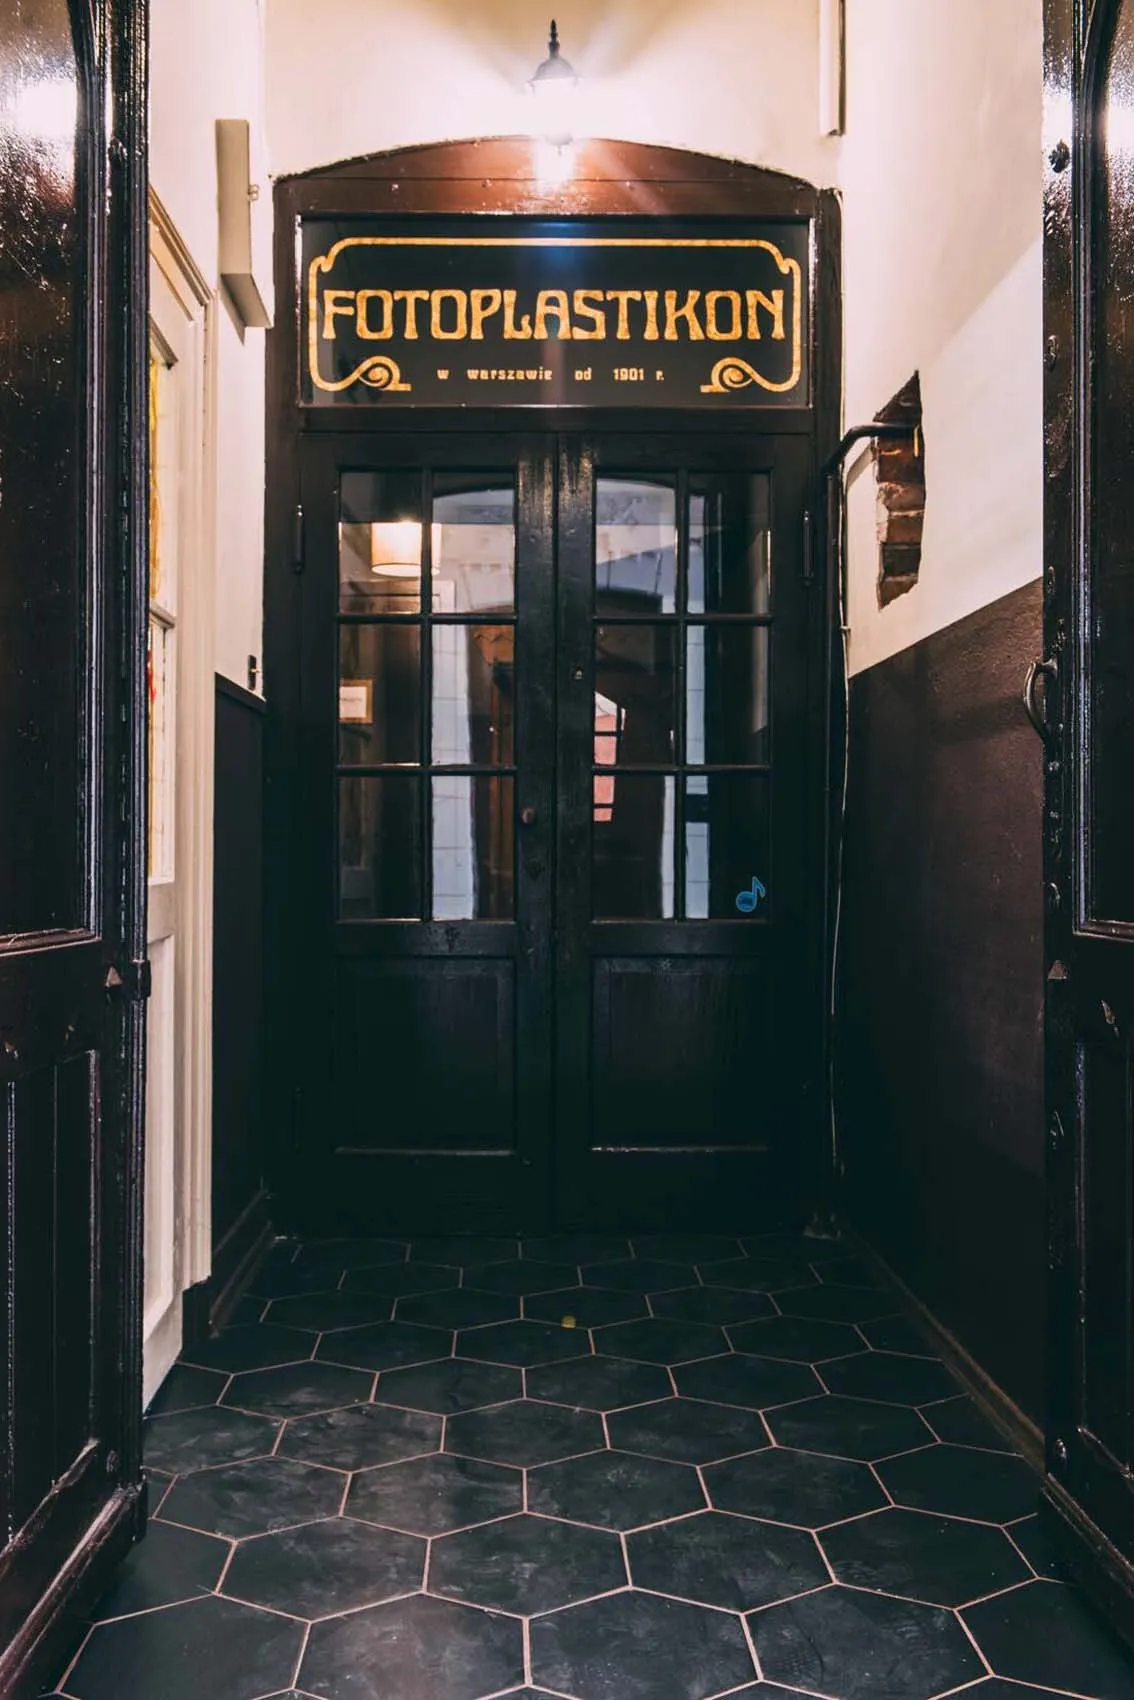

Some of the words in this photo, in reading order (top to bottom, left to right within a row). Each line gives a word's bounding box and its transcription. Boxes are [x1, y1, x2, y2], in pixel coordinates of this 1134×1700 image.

[322, 289, 785, 340] FOTOPLASTIKON
[574, 367, 592, 381] od
[613, 367, 645, 381] 1901
